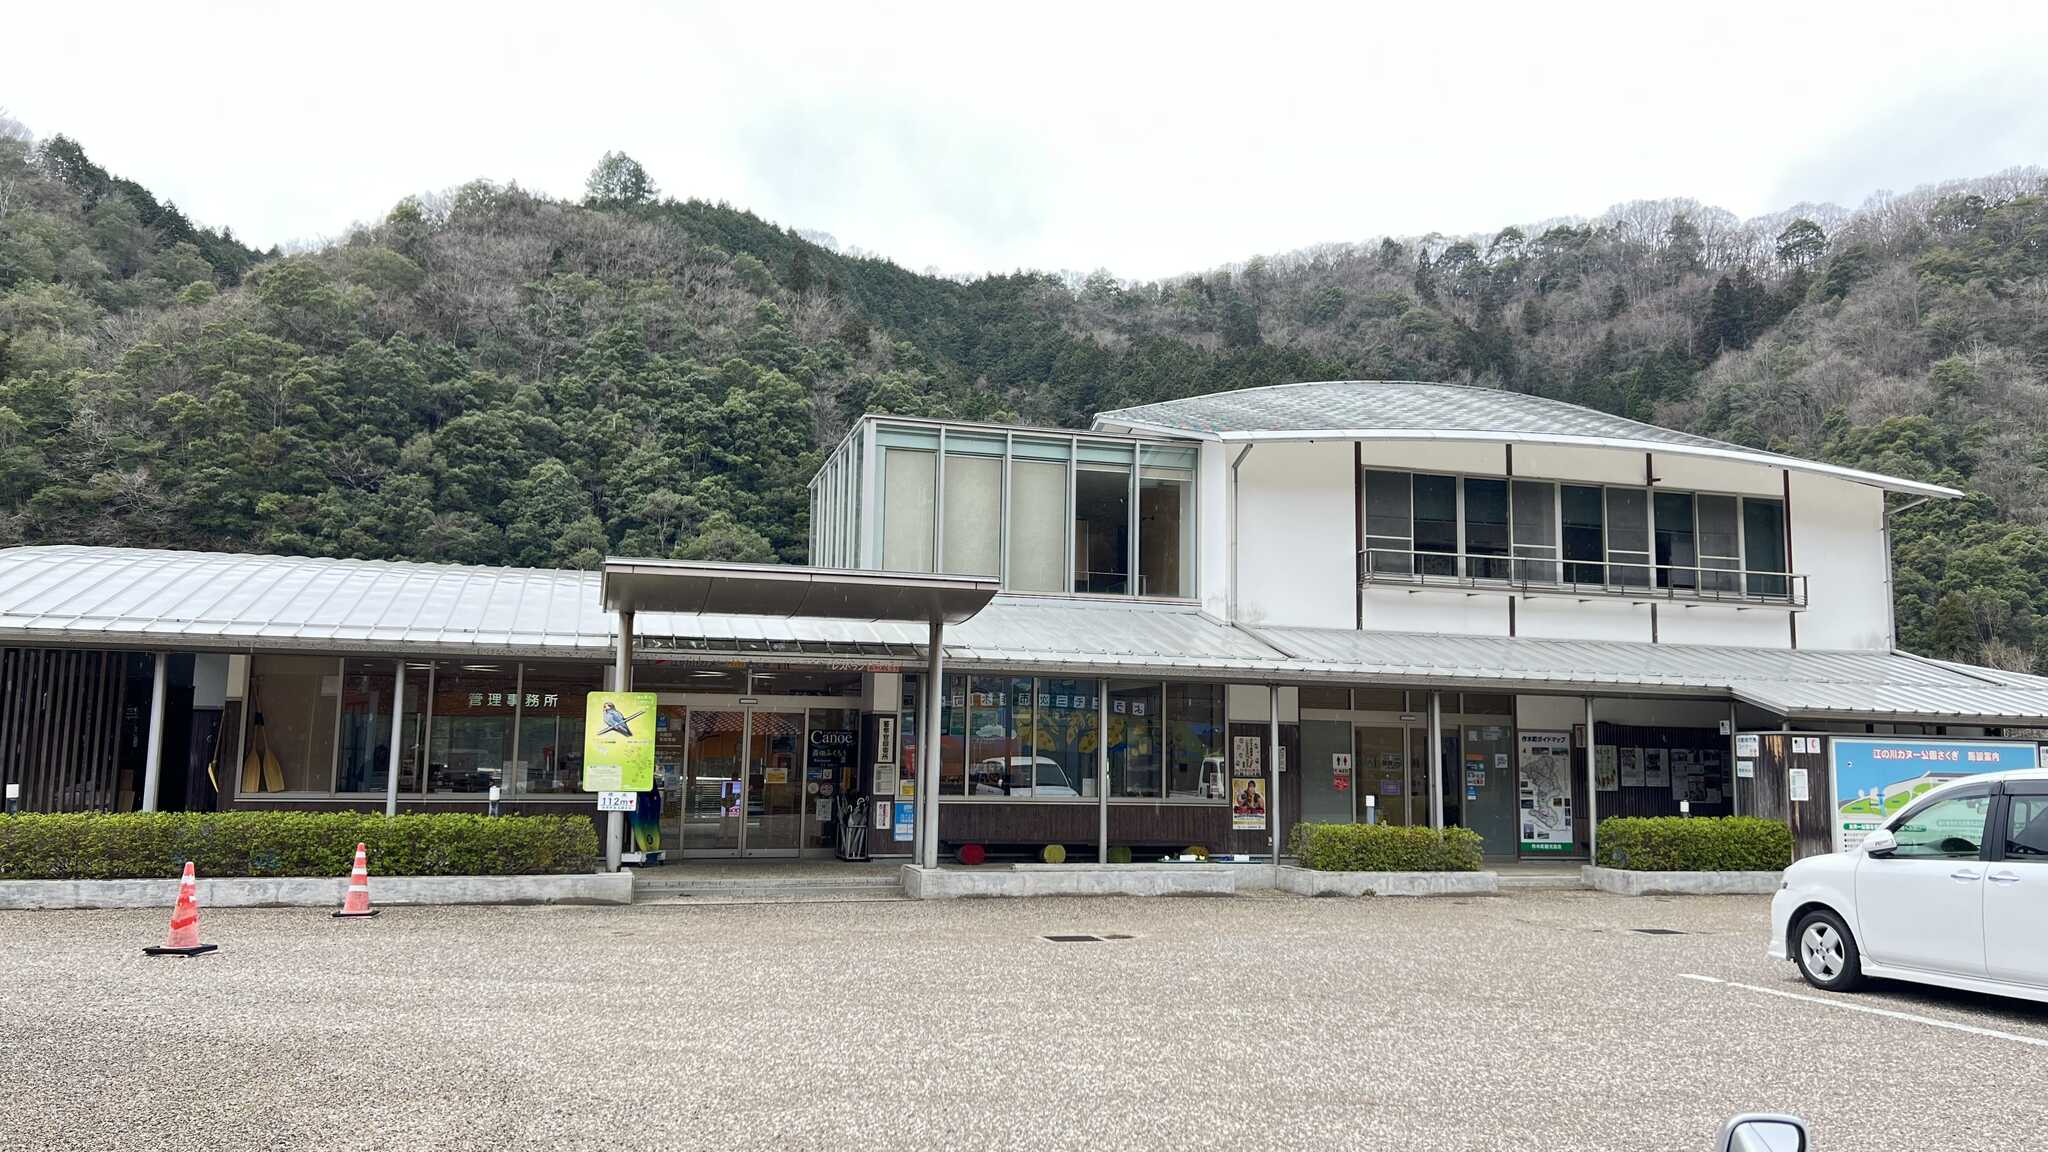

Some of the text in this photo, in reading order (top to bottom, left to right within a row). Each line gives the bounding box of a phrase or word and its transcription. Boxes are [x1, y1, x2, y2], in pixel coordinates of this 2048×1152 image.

[468, 693, 558, 708] 管理事務所
[810, 730, 853, 744] Canoe
[1872, 749, 1959, 761] 江の川カヌー公園さくぎ
[602, 797, 628, 806] 112m
